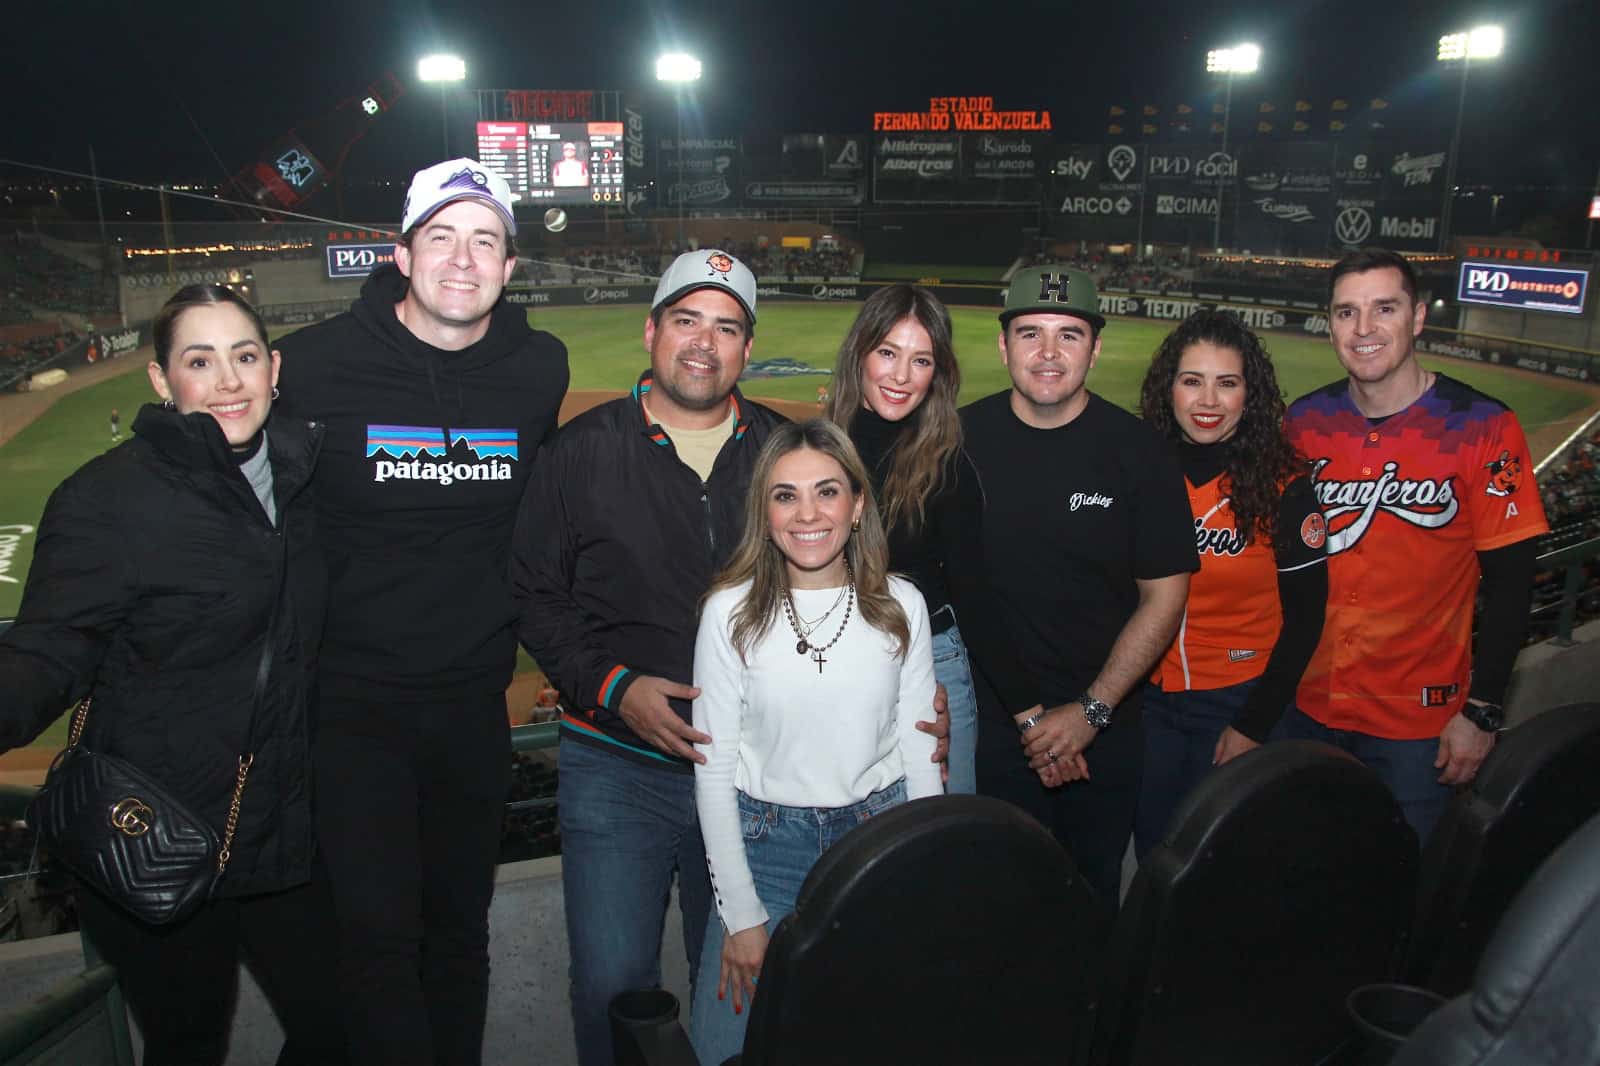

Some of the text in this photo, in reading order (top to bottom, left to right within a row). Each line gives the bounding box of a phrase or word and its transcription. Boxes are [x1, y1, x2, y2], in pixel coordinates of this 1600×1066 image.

[930, 97, 993, 112] ESTADIO
[873, 111, 1052, 131] FERNANDO VALENZUELA
[624, 109, 645, 168] telcel
[883, 158, 954, 177] Albatros
[1057, 156, 1093, 180] sky
[1060, 197, 1113, 214] ARCO
[1174, 198, 1219, 214] CIMA
[1380, 217, 1436, 238] Mobil
[600, 289, 629, 300] pepsi
[828, 287, 857, 298] pepsi
[1038, 272, 1069, 304] H
[374, 459, 512, 486] patagonia
[1070, 492, 1114, 511] Dickies
[1504, 501, 1520, 520] A
